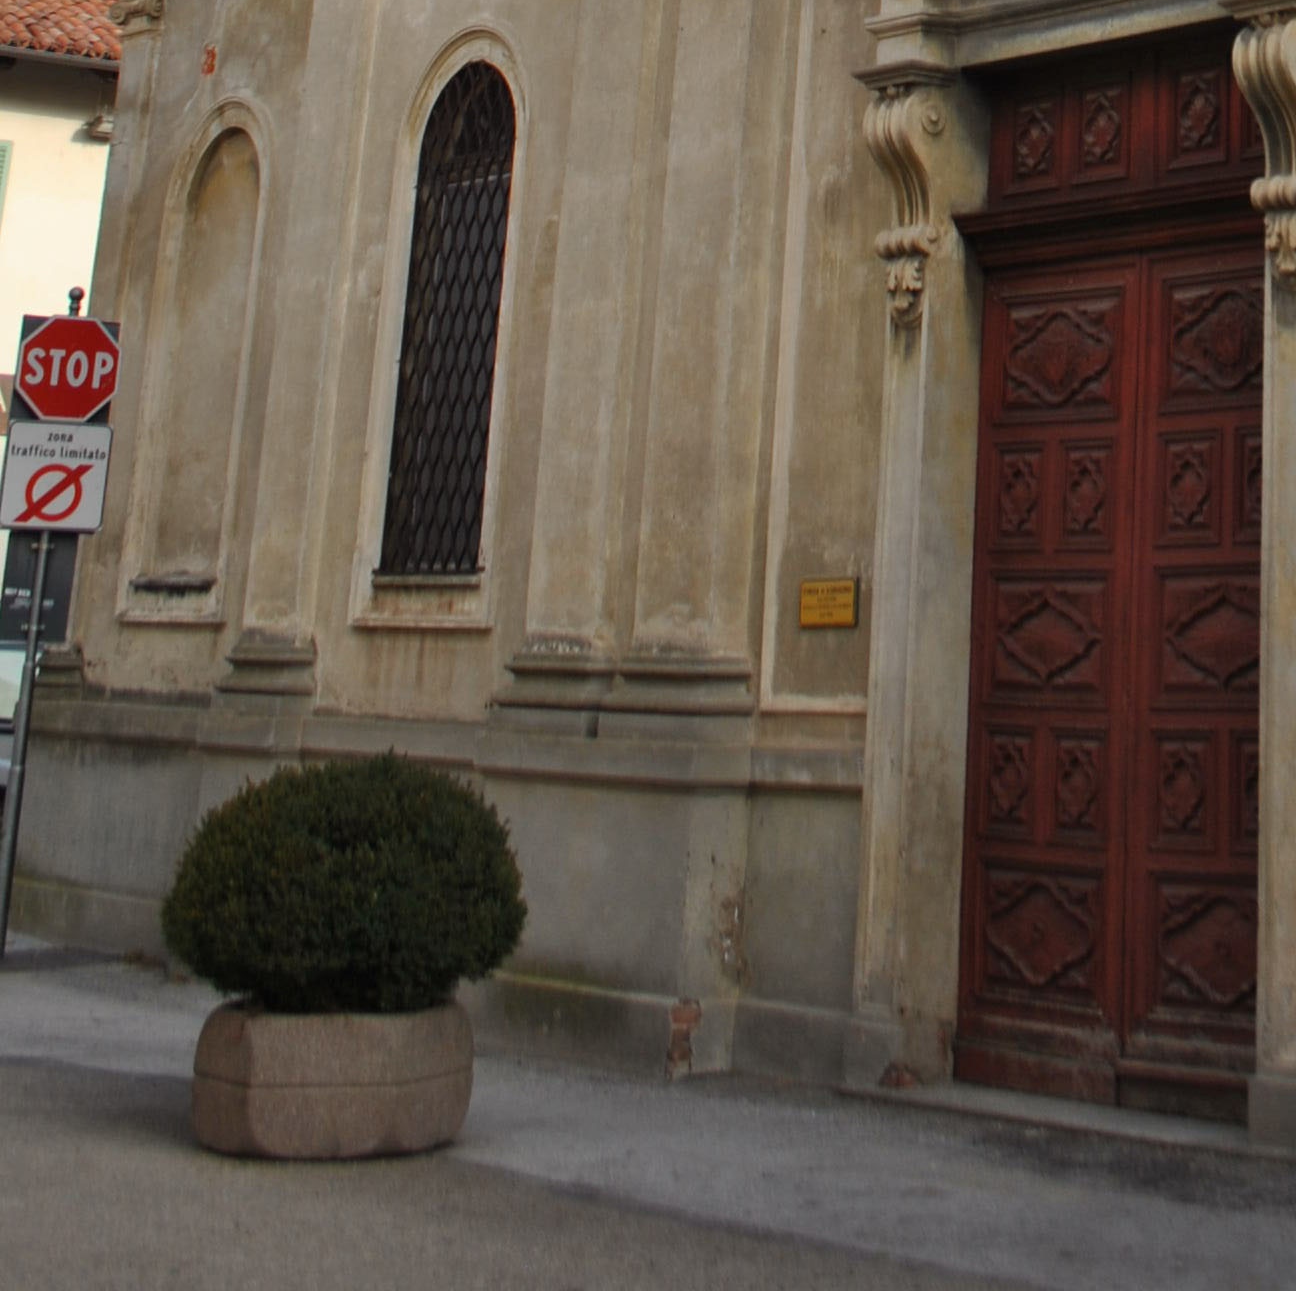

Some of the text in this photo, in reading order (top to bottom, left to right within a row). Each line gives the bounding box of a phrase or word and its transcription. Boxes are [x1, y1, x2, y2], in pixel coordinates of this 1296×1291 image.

[25, 347, 114, 389] STOP
[47, 432, 74, 442] zona
[11, 445, 106, 459] traffico limitato
